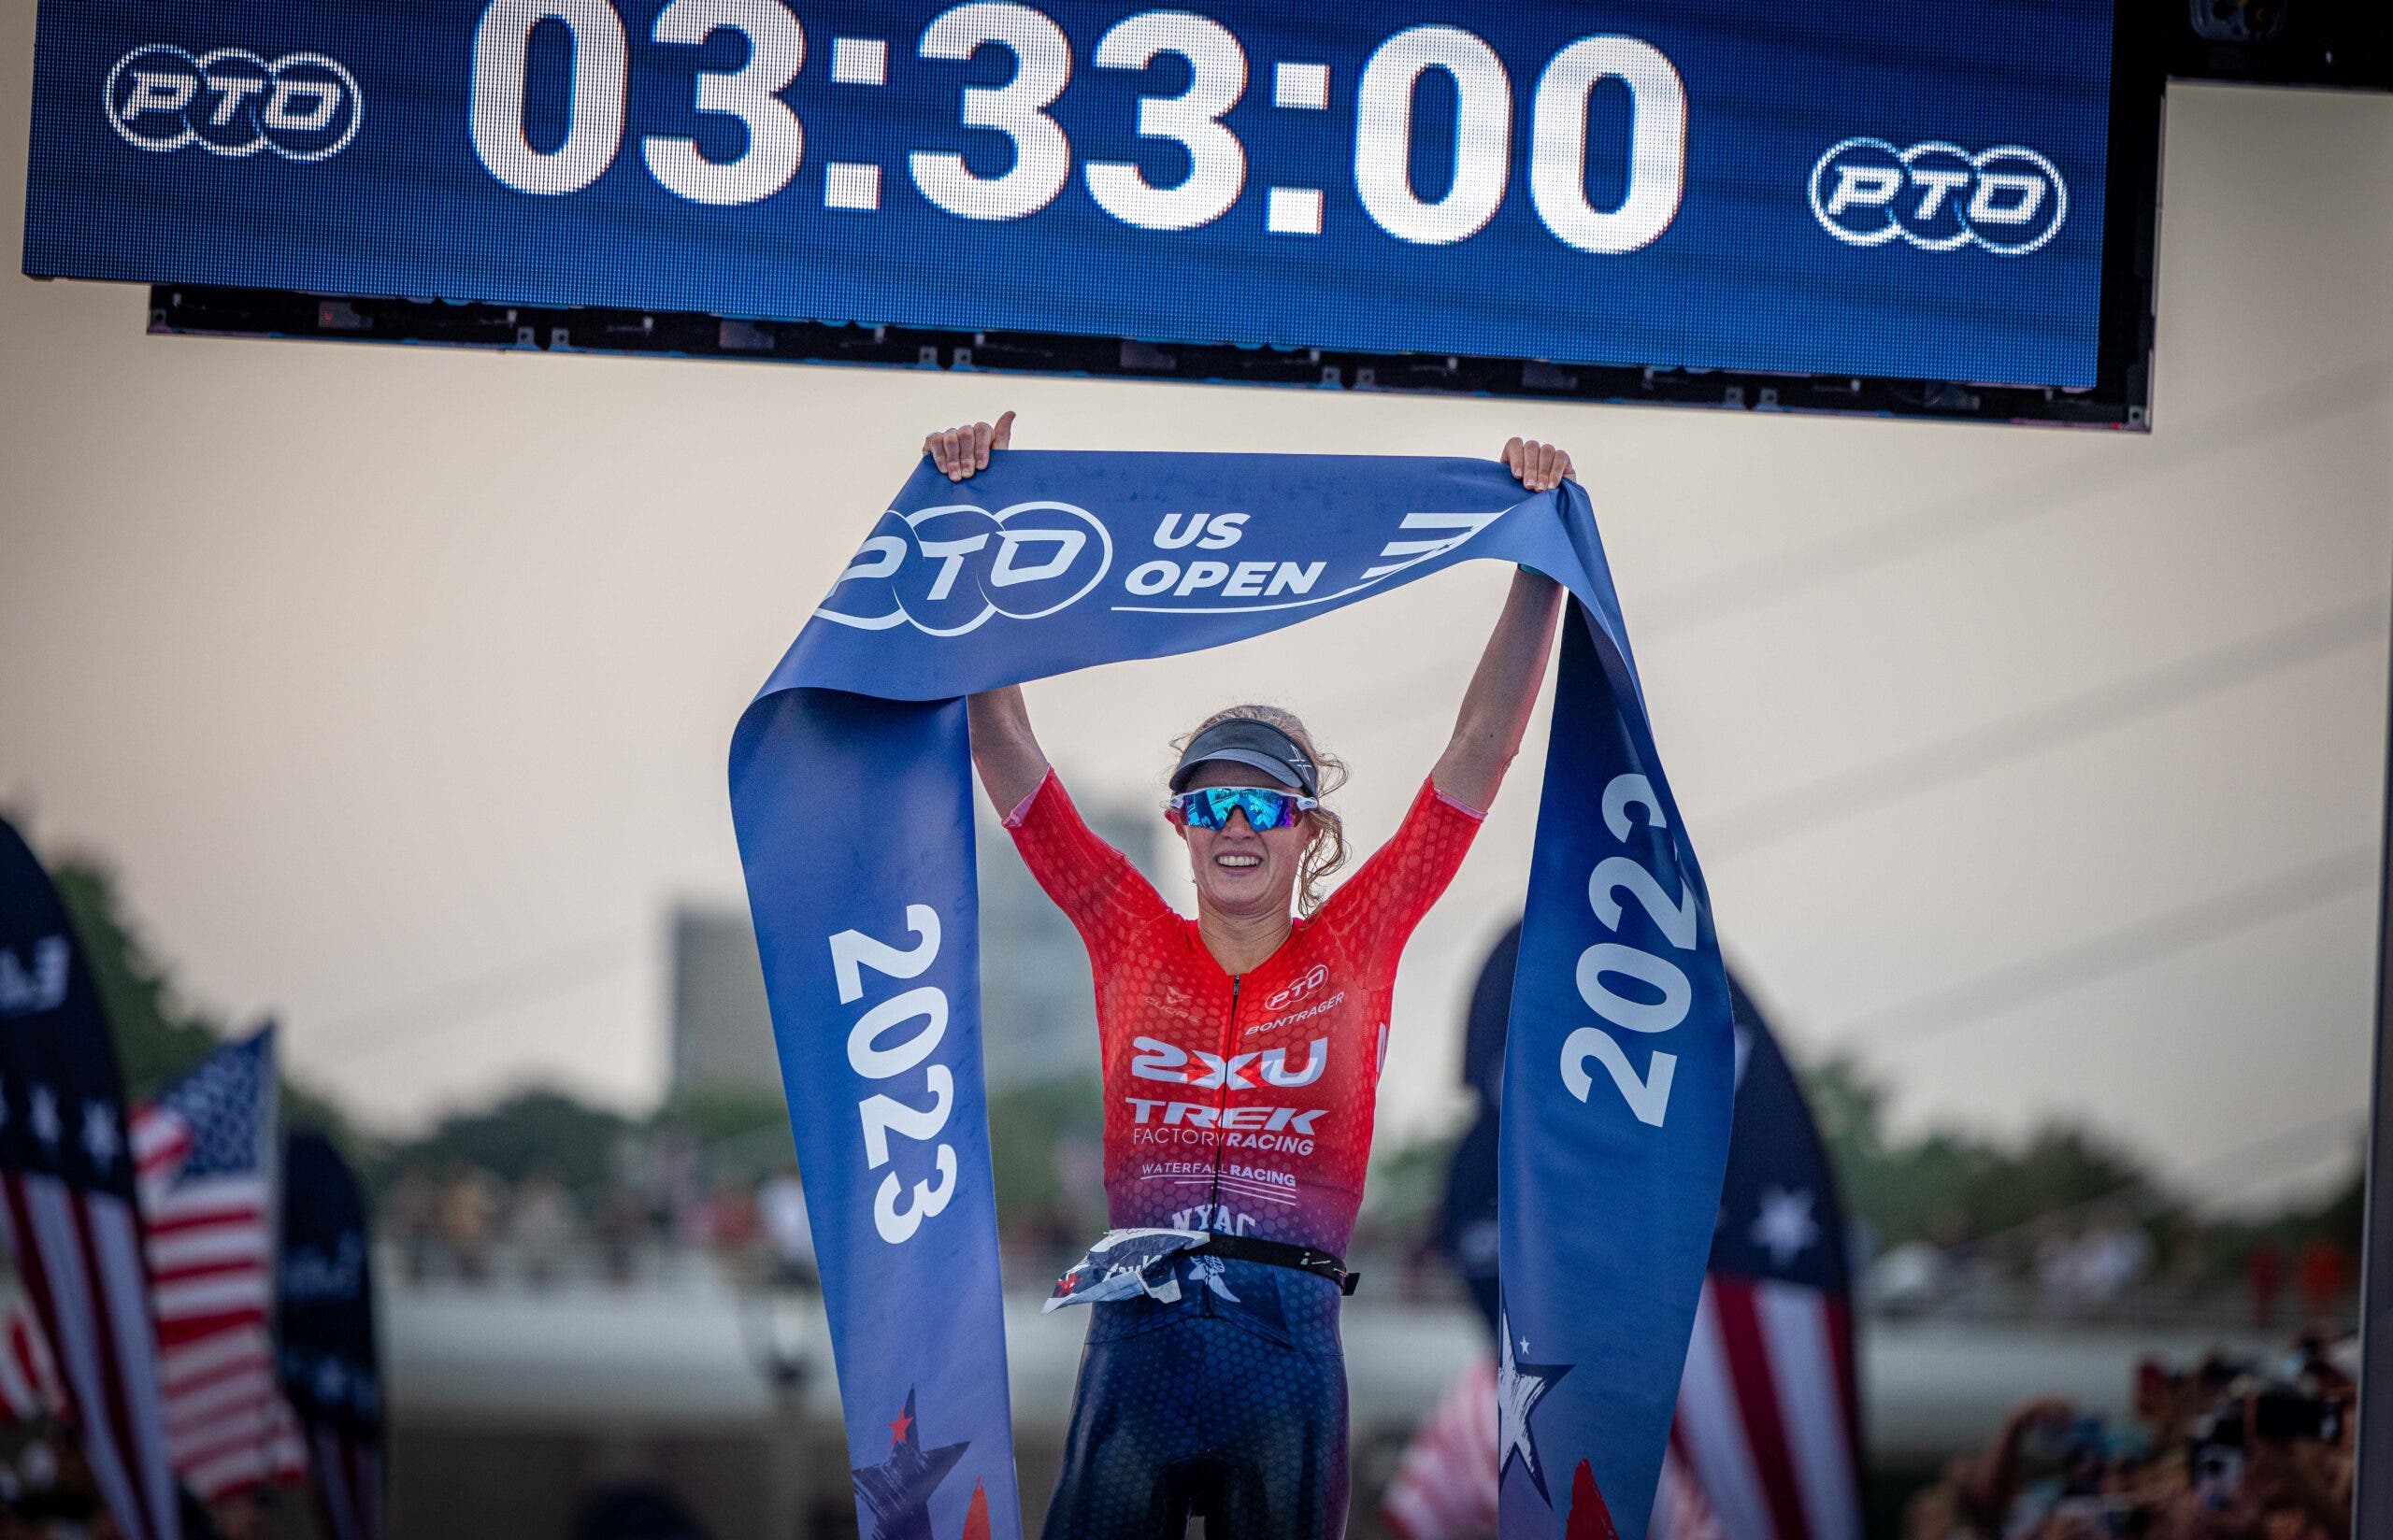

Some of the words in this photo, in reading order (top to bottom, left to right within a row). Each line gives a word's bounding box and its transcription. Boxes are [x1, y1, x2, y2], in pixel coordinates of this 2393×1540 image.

[469, 0, 1685, 253] 03:33:00
[1154, 513, 1251, 549] US
[1125, 561, 1327, 596] OPEN
[1269, 968, 1325, 1008] PTO
[1244, 991, 1345, 1036] BONTRAGER
[829, 904, 957, 1245] 2023
[1131, 1036, 1328, 1091] 2XU
[1125, 1097, 1329, 1135] TREK
[1133, 1127, 1224, 1146] FACTORY
[1226, 1133, 1314, 1156] RACING
[1141, 1162, 1227, 1175] WATERFALL
[1229, 1164, 1297, 1187] RACING
